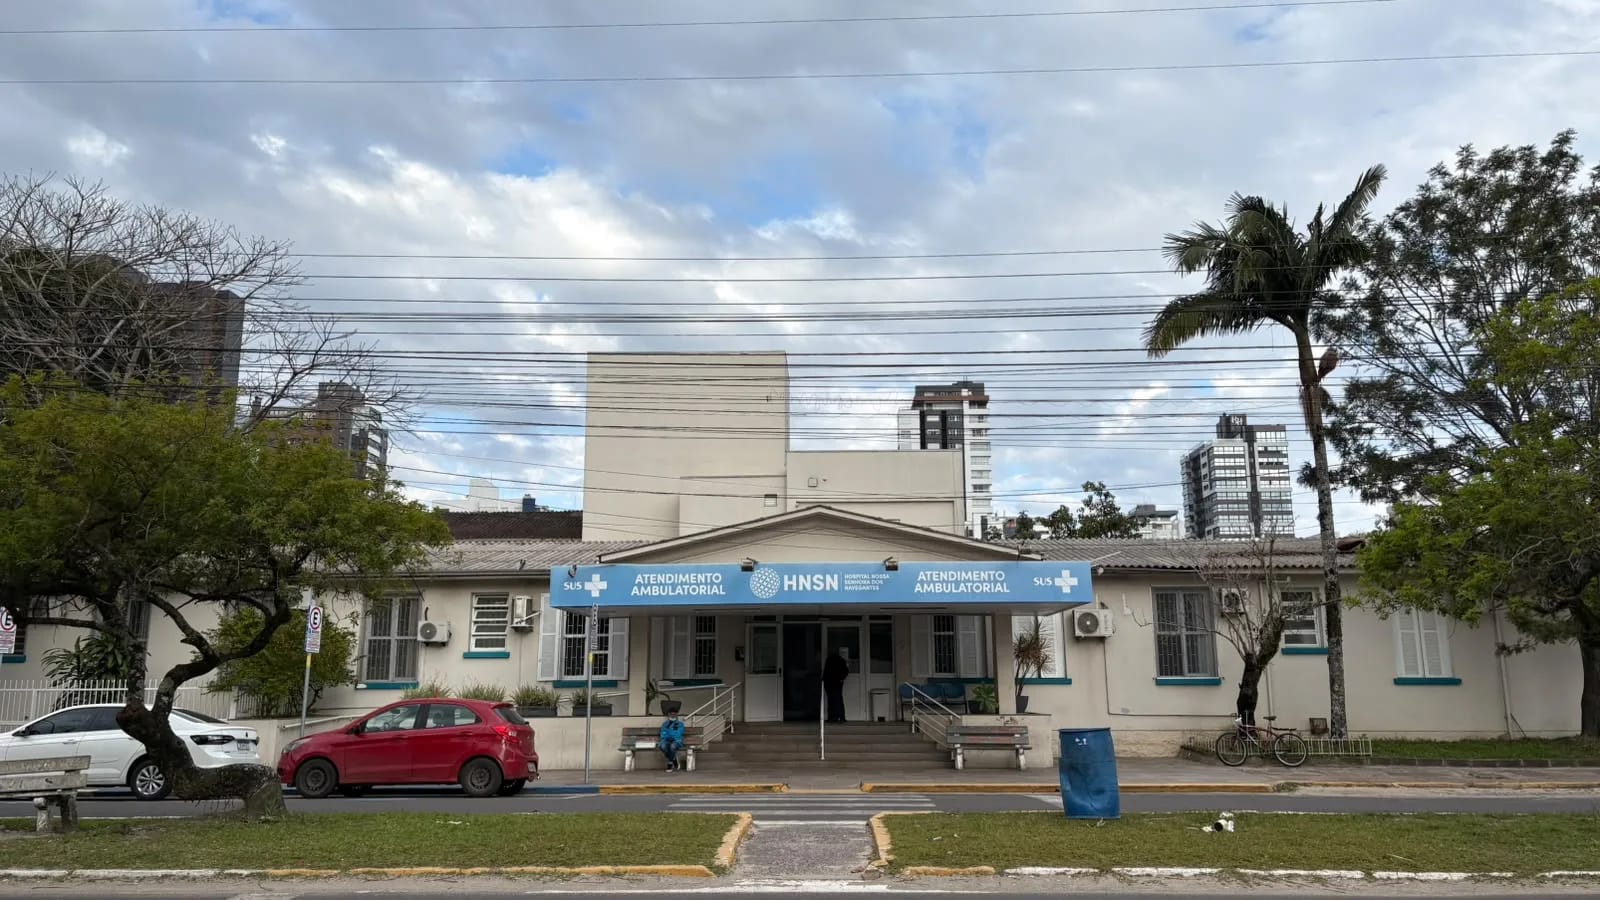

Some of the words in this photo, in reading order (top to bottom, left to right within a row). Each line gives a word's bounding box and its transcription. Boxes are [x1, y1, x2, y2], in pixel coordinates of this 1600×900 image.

[634, 572, 722, 584] ATENDIMENTO
[917, 571, 1005, 582] ATENDIMENTO
[1033, 577, 1052, 586] SUS
[563, 581, 582, 591] SUS
[784, 574, 838, 591] HNSN
[914, 582, 1010, 593] AMBULATORIAL
[631, 584, 726, 596] AMBULATORIAL
[313, 612, 318, 625] E
